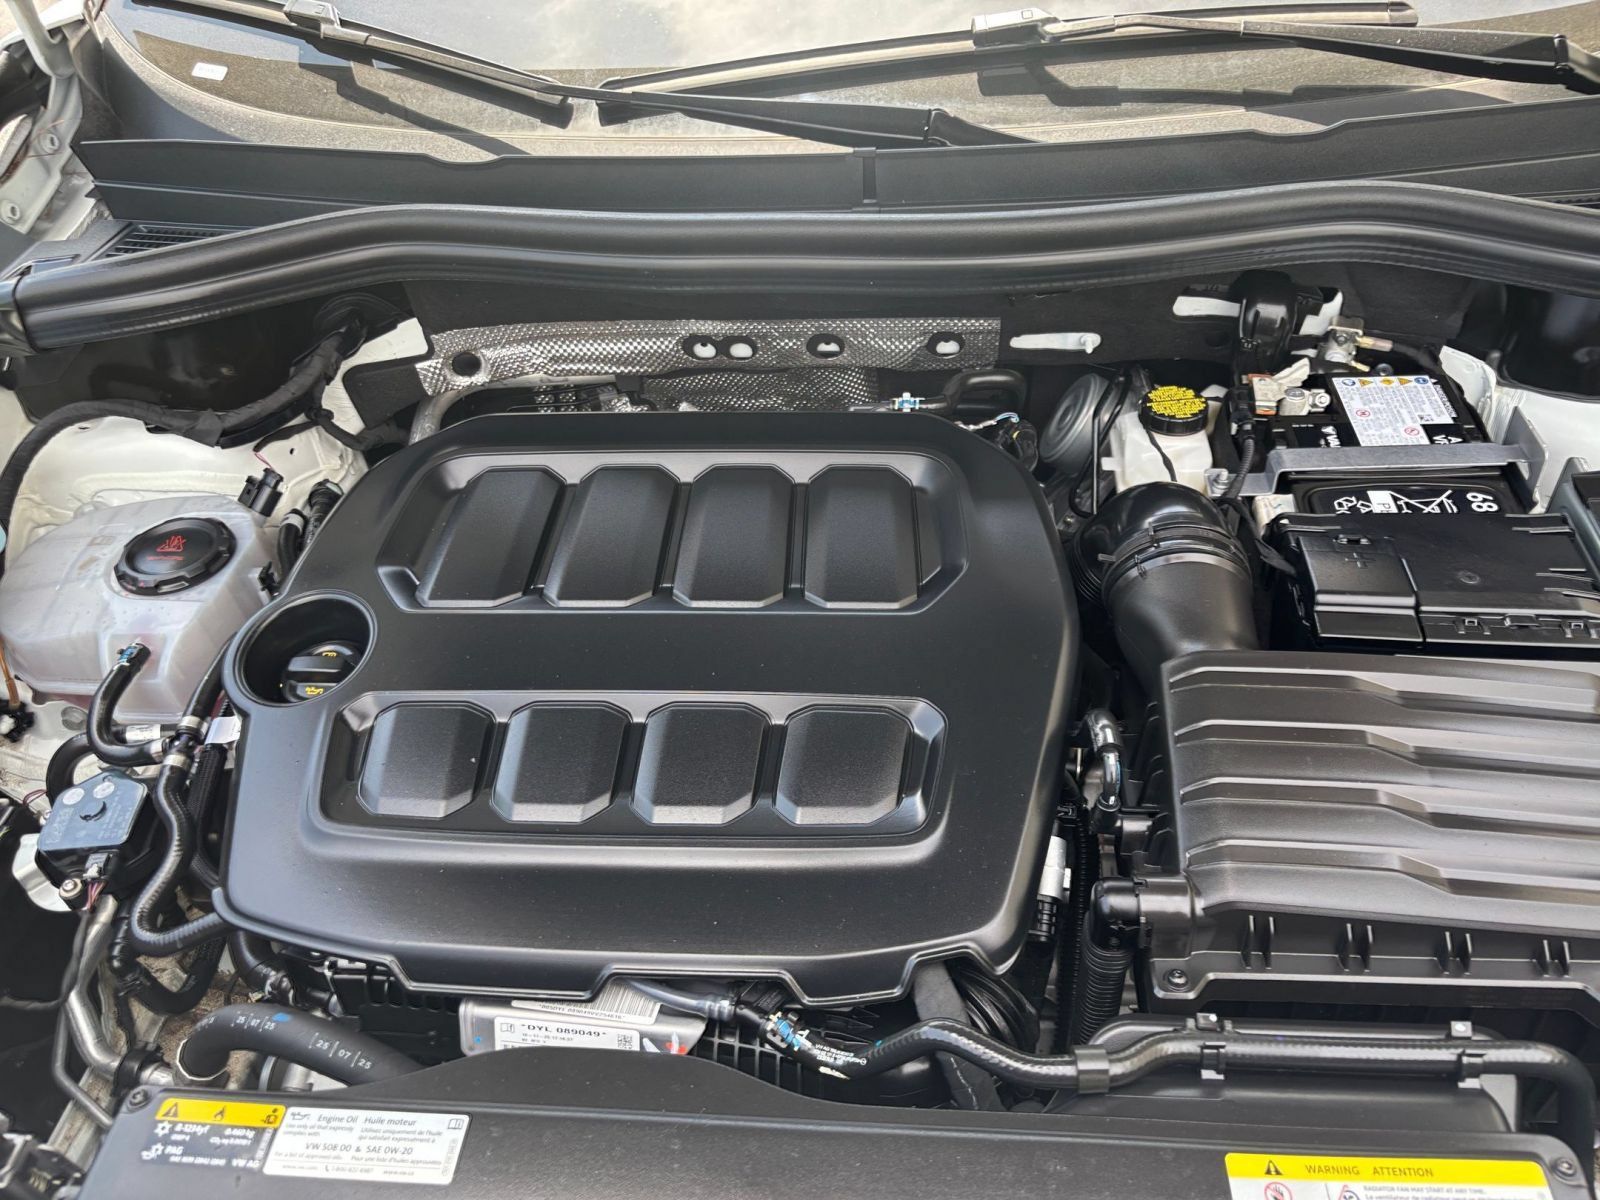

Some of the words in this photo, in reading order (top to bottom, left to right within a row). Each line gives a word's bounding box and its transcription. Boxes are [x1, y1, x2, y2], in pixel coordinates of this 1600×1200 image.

[1466, 492, 1498, 512] 68
[317, 1114, 344, 1124] Engine
[346, 1115, 359, 1123] Oil
[364, 1116, 385, 1125] Huile
[386, 1118, 417, 1126] moteur
[305, 1142, 320, 1150] VW
[322, 1143, 338, 1151] 508
[339, 1144, 352, 1152] 00
[355, 1145, 362, 1153] &
[366, 1145, 382, 1154] SAE
[384, 1146, 414, 1155] 0W-20
[1304, 1163, 1361, 1177] WARNING
[1372, 1166, 1434, 1178] ATTENTION
